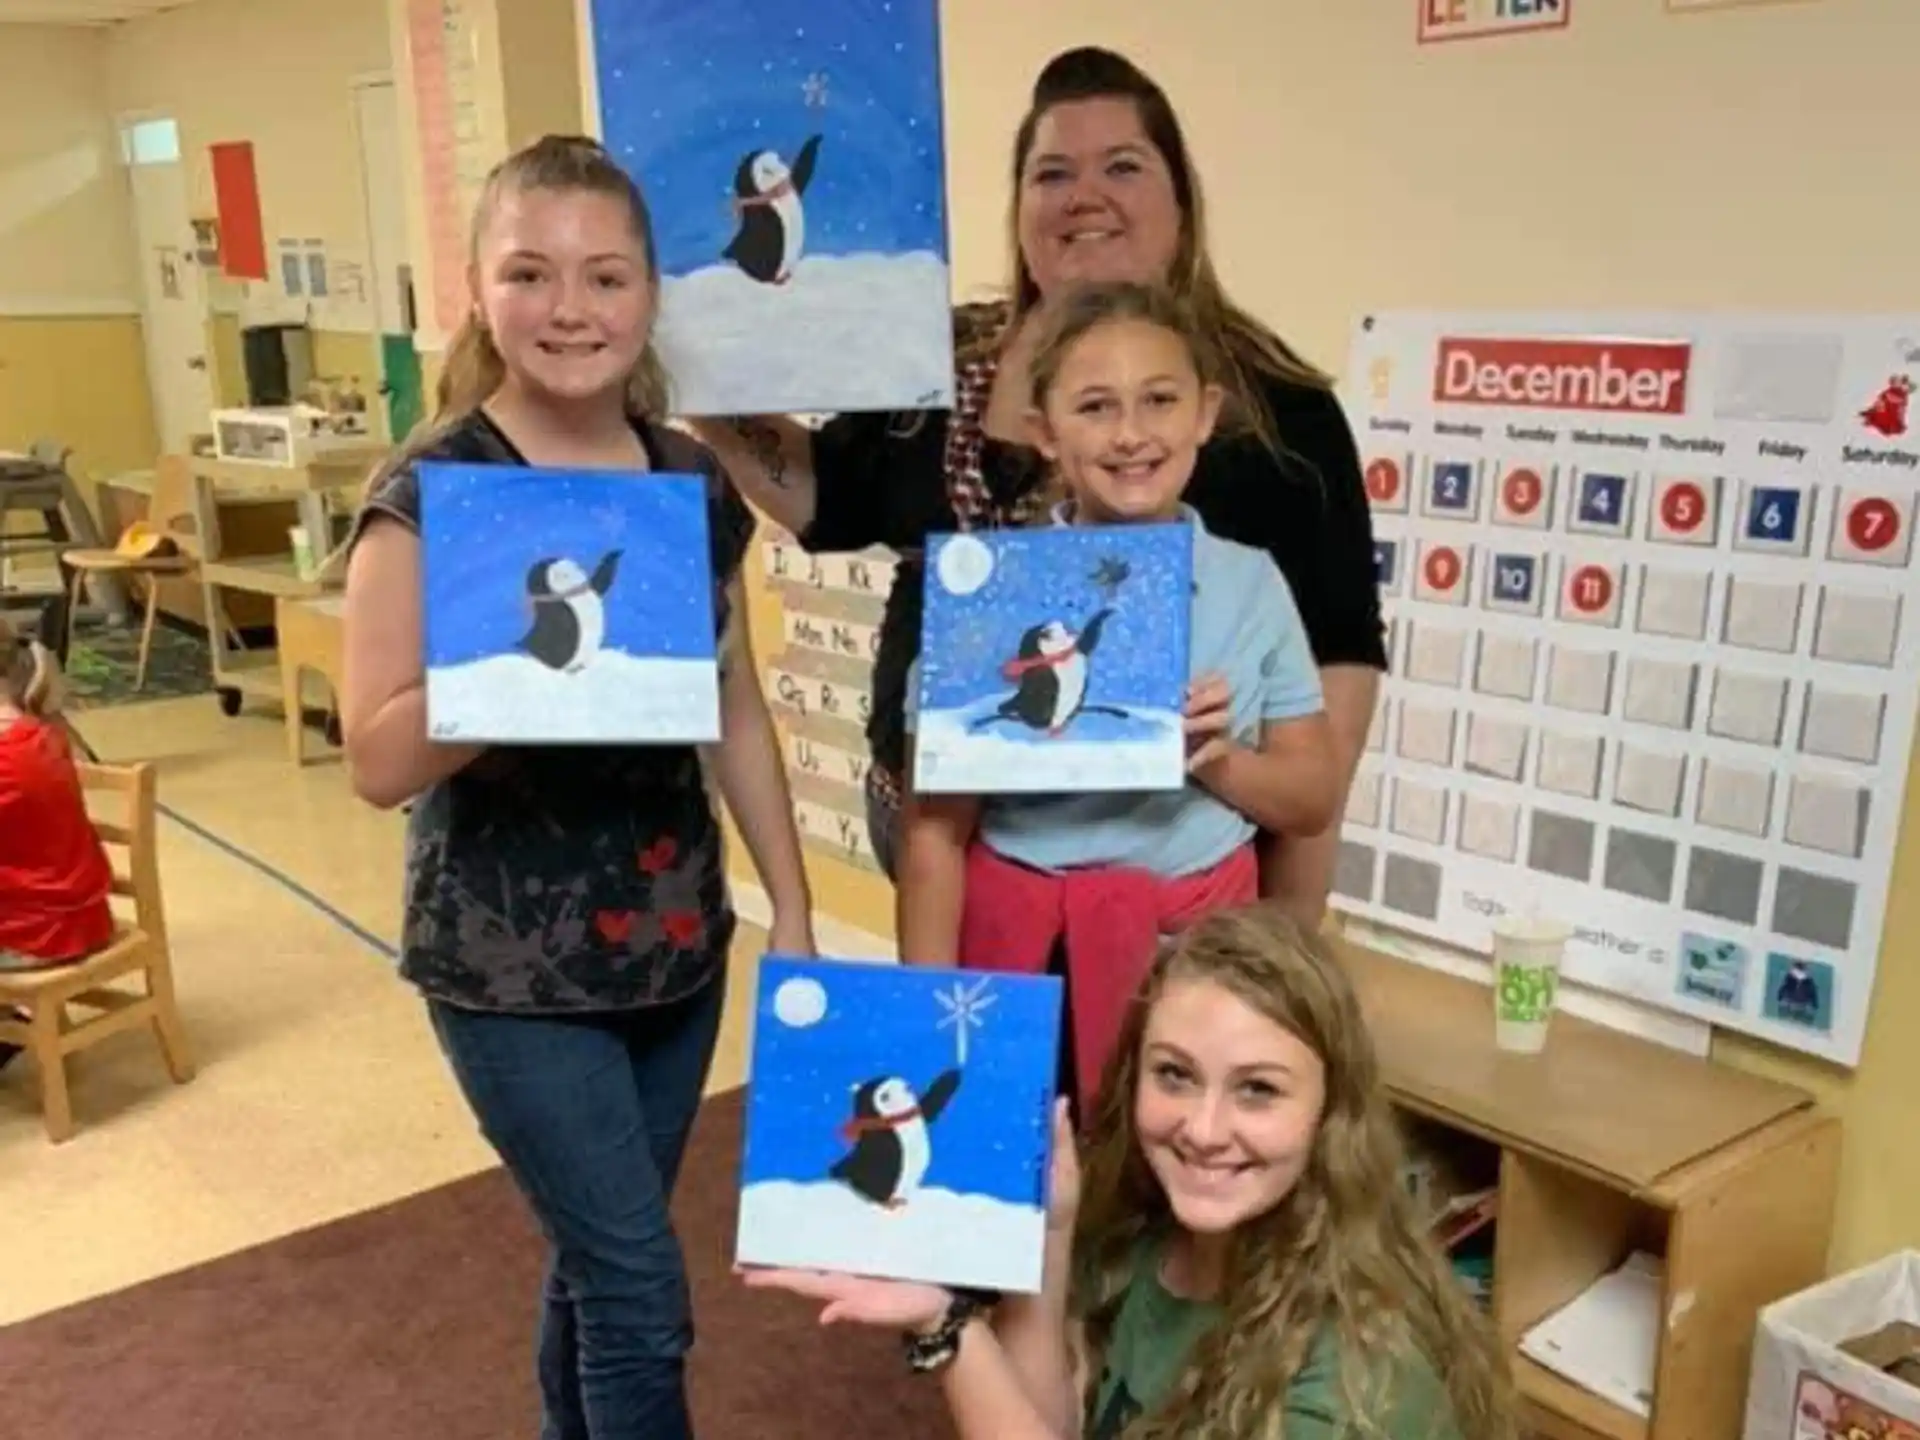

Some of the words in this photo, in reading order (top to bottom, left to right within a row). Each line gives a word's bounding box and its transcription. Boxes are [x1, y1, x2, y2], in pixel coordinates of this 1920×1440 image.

[1444, 350, 1681, 408] December
[1572, 429, 1649, 452] Wednesday
[1659, 432, 1725, 456] Thursday
[1758, 438, 1807, 463] Friday
[1842, 444, 1919, 468] Saturday
[1376, 467, 1387, 492] 1
[1442, 475, 1459, 499] 2
[1515, 480, 1531, 504] 3
[1591, 486, 1610, 513] 4
[1673, 495, 1692, 521] 5
[1761, 501, 1782, 530] 6
[1864, 512, 1884, 540] 7
[1434, 558, 1450, 583] 9
[1500, 567, 1527, 590] 10
[1580, 576, 1601, 602] 11
